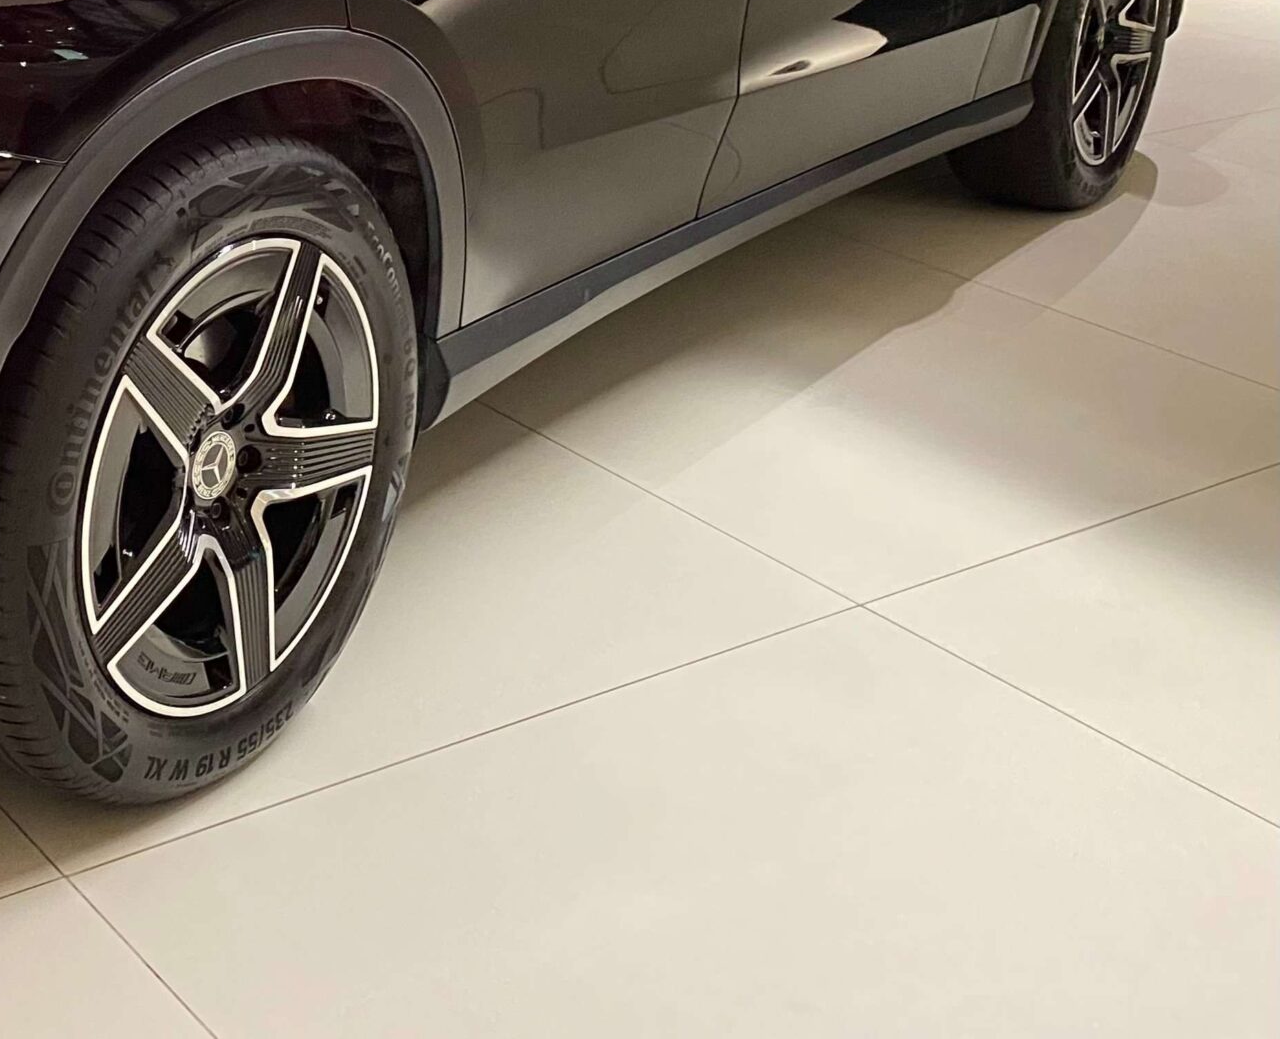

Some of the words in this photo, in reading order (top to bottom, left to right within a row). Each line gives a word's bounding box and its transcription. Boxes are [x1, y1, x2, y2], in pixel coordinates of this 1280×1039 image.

[49, 271, 156, 514] Continental
[137, 651, 196, 685] AMG
[236, 701, 295, 761] 235/55
[144, 756, 168, 781] XL
[169, 759, 189, 781] W
[195, 754, 214, 778] 19
[219, 747, 231, 769] R
